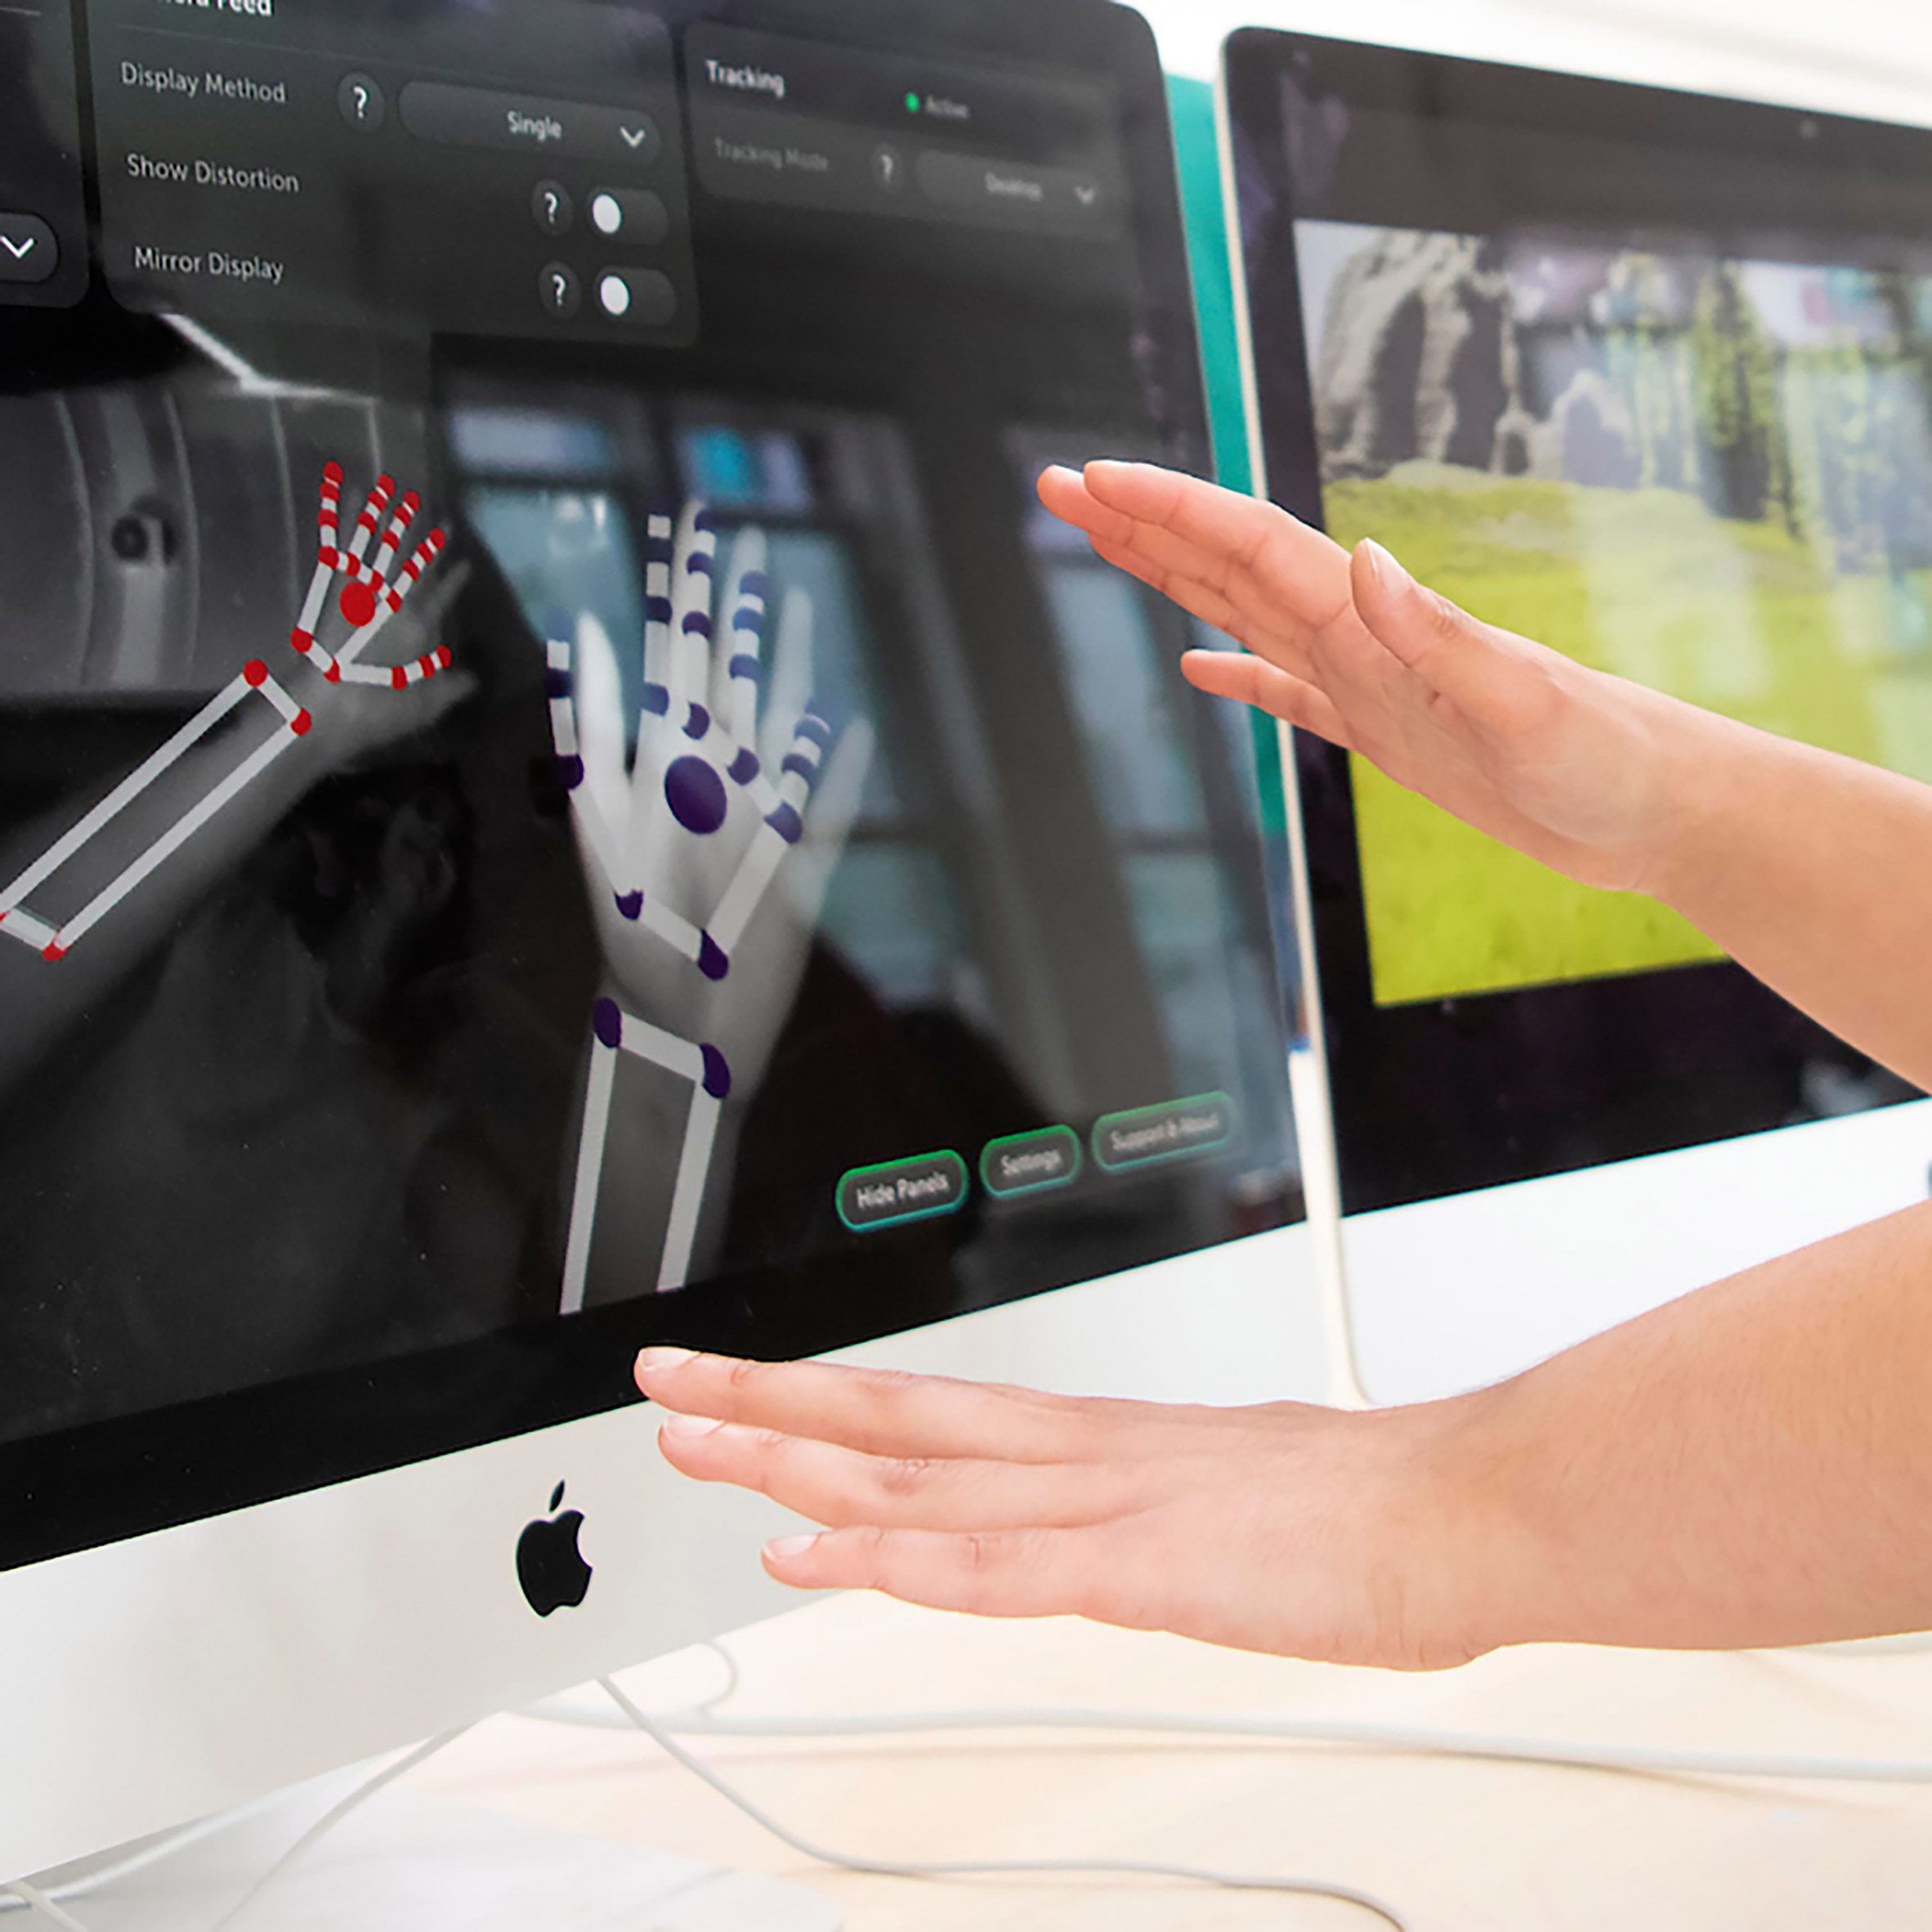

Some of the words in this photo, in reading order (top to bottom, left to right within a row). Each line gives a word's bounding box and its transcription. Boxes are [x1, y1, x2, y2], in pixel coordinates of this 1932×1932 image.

[121, 60, 199, 98] Display
[205, 72, 286, 103] Method
[705, 59, 785, 99] Tracking
[353, 86, 367, 119] ?
[507, 110, 561, 141] Single
[714, 136, 783, 170] Tracking
[127, 153, 188, 181] Show
[195, 160, 299, 193] Distortion
[544, 191, 557, 224] ?
[135, 246, 202, 272] Mirror
[208, 251, 284, 285] Display
[552, 274, 566, 306] ?
[1000, 1149, 1062, 1177] Settings
[856, 1184, 897, 1210] Hide
[897, 1171, 950, 1200] Panels
